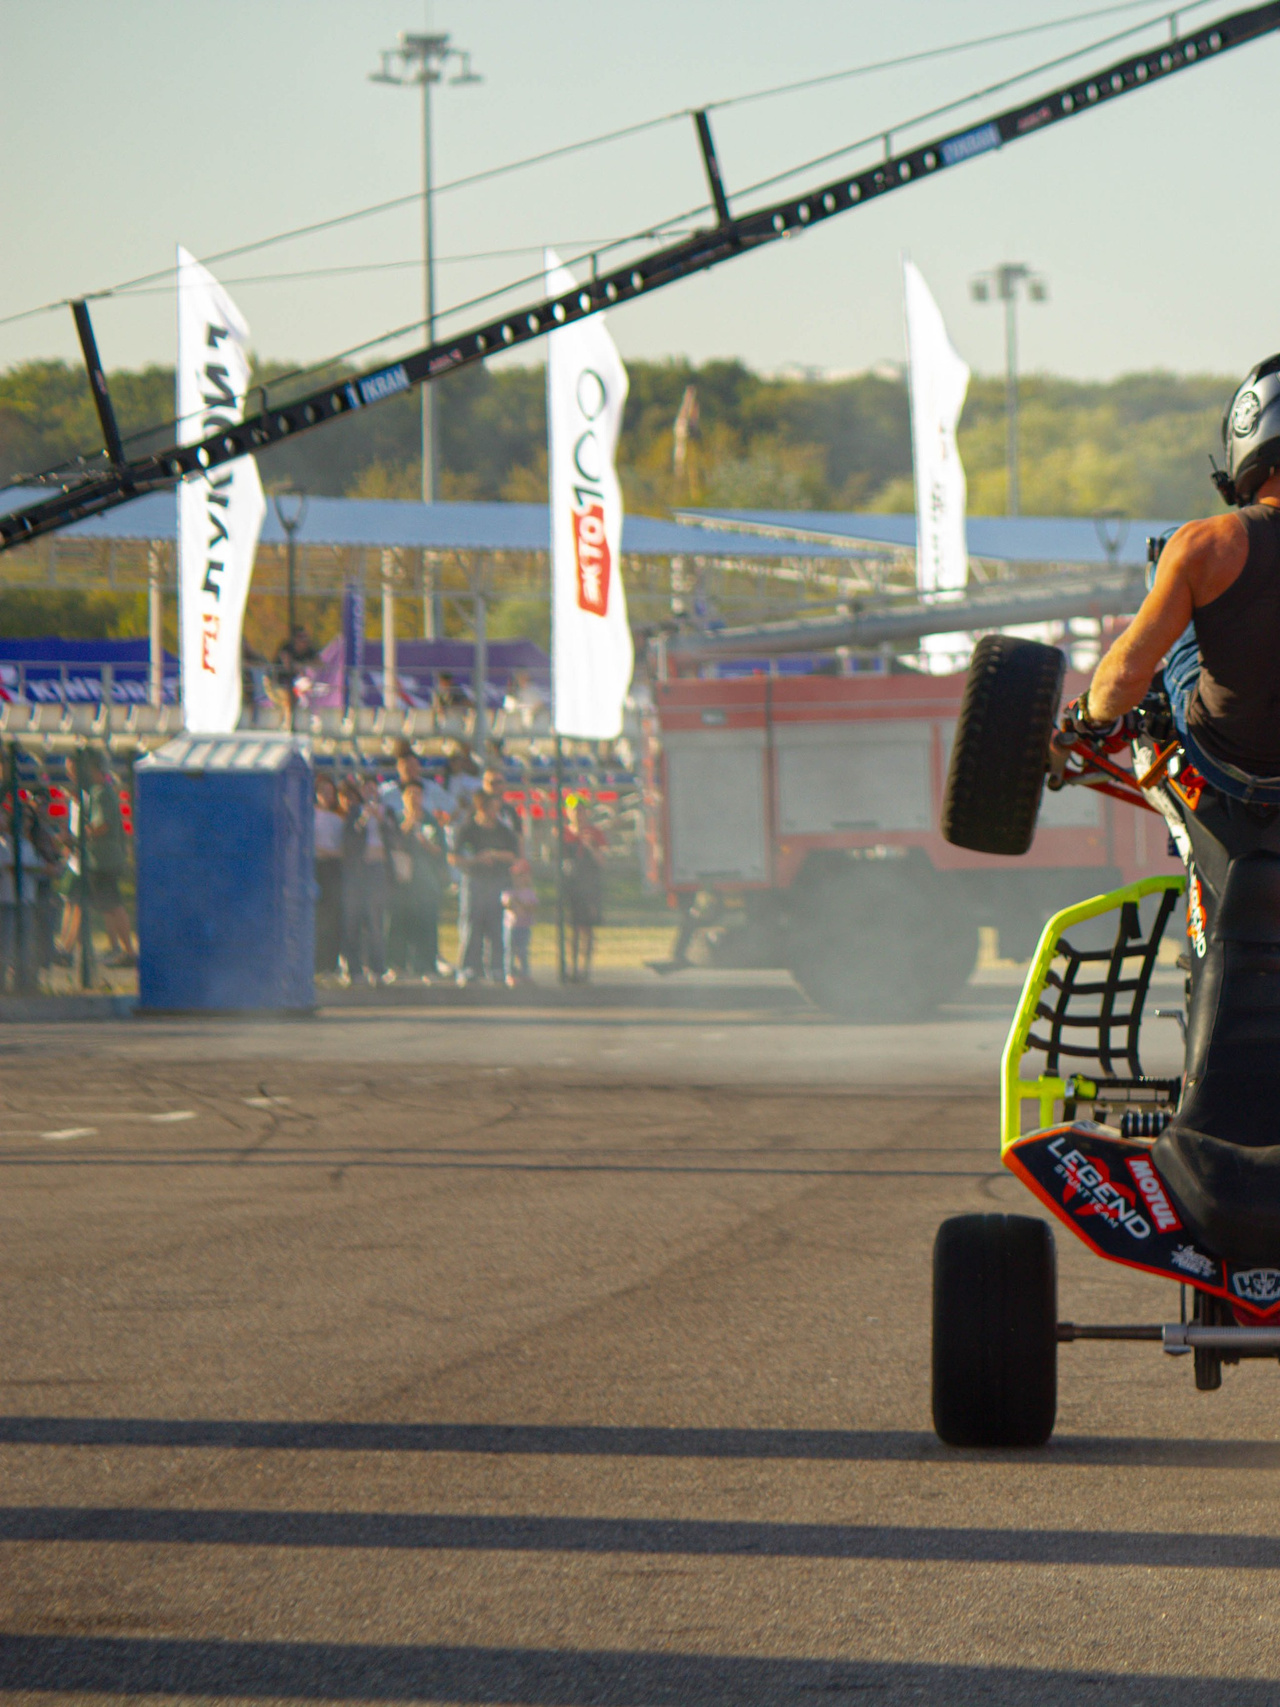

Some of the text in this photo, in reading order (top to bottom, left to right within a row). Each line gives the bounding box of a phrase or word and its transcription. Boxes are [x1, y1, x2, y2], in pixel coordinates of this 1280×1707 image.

[1047, 1136, 1151, 1239] LEGEND
[1054, 1164, 1119, 1229] STUNT TEAM
[1129, 1160, 1177, 1231] MOTUL
